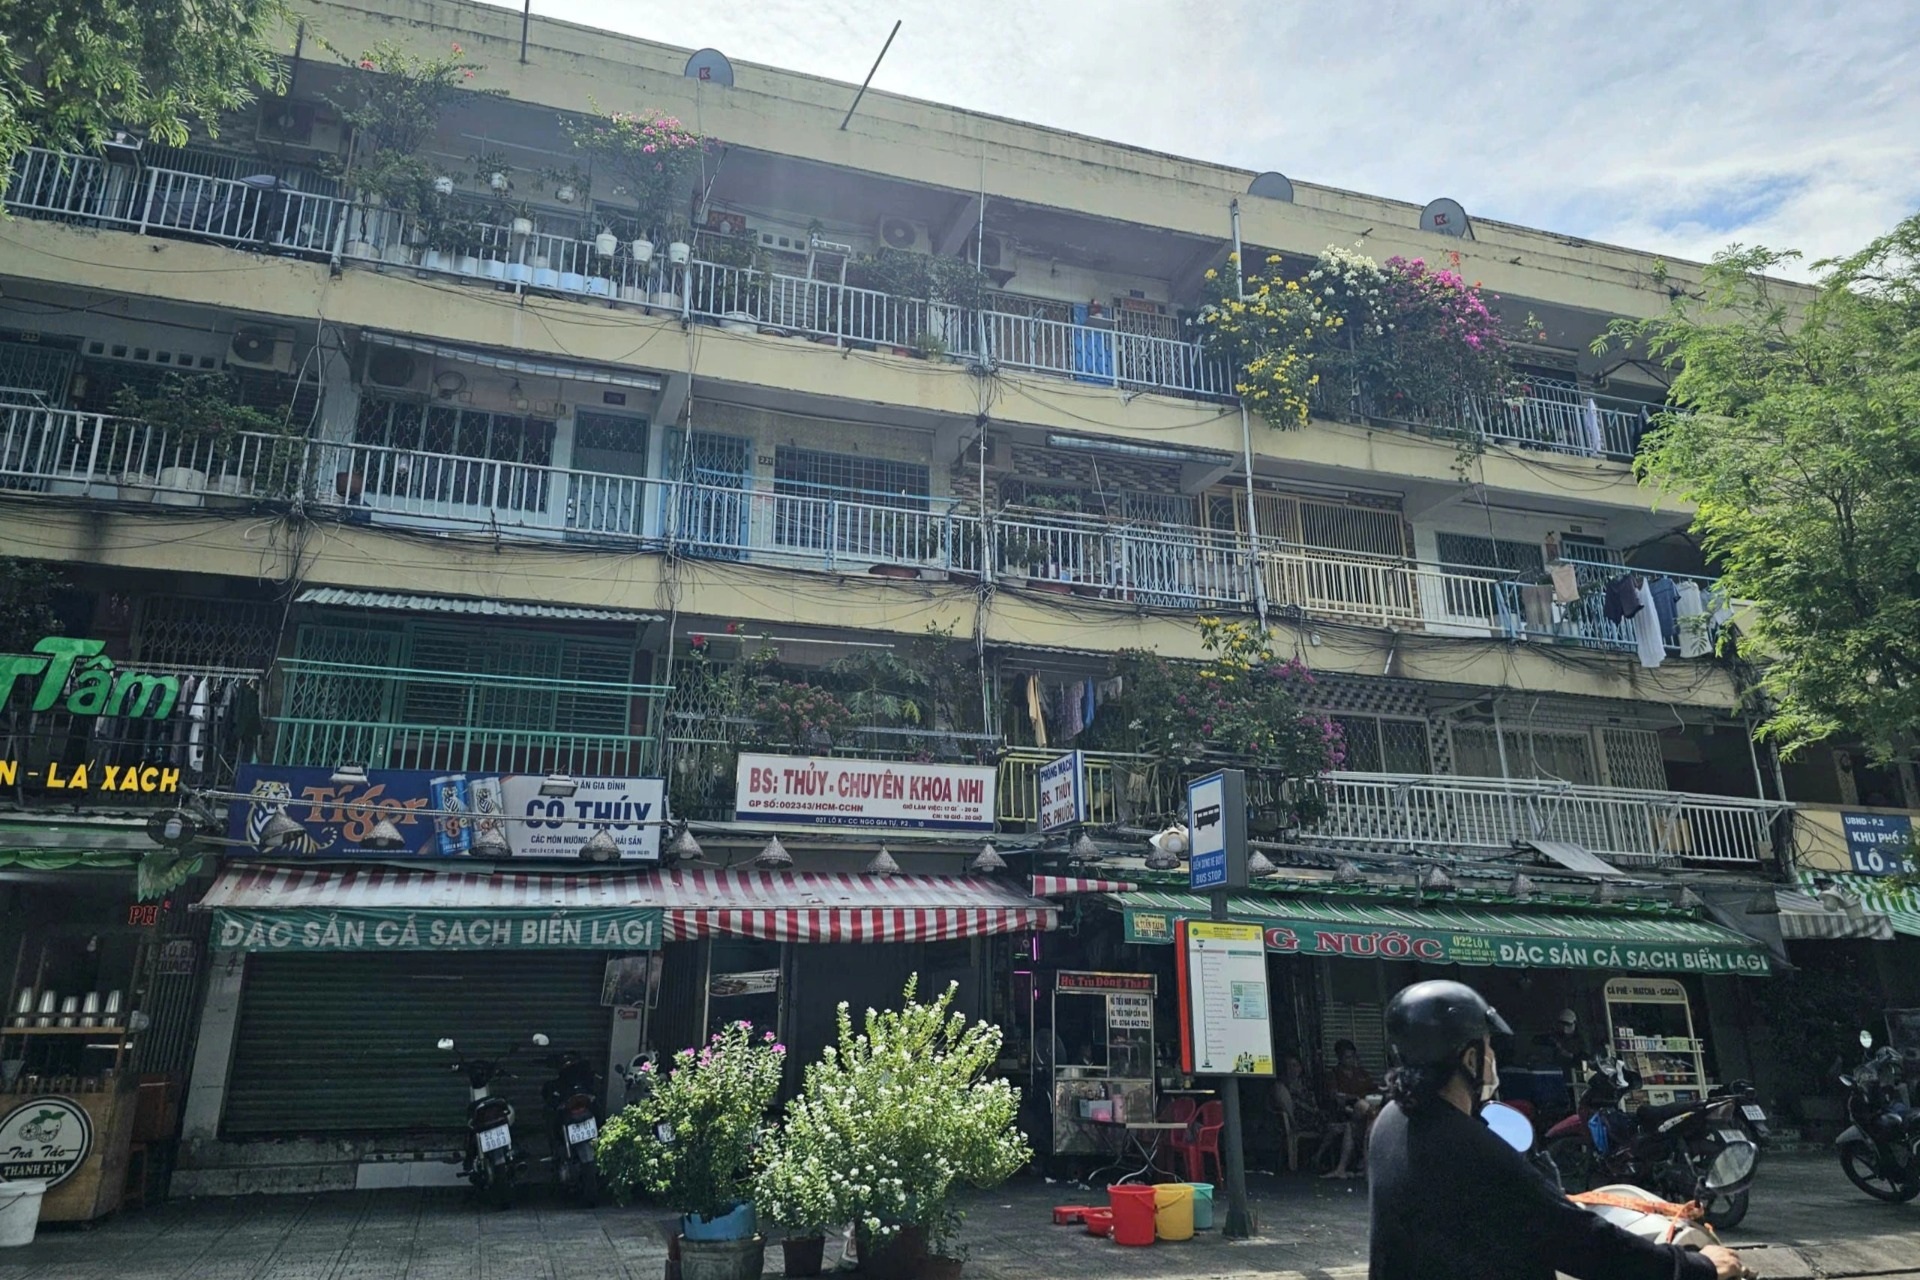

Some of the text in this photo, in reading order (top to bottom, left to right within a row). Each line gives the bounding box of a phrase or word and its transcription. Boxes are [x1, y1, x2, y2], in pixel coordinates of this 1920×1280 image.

[32, 637, 179, 720] Tâm
[47, 759, 95, 789] LÁ
[101, 761, 180, 793] XÁCH
[1057, 758, 1073, 775] MẠCH
[592, 781, 605, 790] GIA
[607, 781, 626, 791] ĐÌNH
[784, 762, 829, 796] THỦY
[838, 769, 904, 800] CHUYÊN
[910, 775, 953, 803] KHOA
[957, 779, 984, 804] NHI
[1055, 776, 1071, 802] THỦY
[574, 795, 652, 831] THÚY
[829, 816, 837, 824] LÔ
[1845, 817, 1867, 826] UBND
[531, 834, 545, 844] CÁC
[1852, 831, 1876, 843] KHU
[1878, 830, 1899, 844] PHỐ
[1855, 848, 1884, 871] LÔ
[1196, 869, 1222, 884] BUS STOP
[221, 914, 293, 952] ĐẶC
[302, 913, 365, 947] SẢN
[429, 918, 512, 950] SẠCH
[521, 909, 582, 945] BIỂN
[590, 919, 653, 946] LAGI
[1314, 931, 1444, 959] NƯỚC
[1473, 936, 1483, 948] LÔ
[1500, 941, 1769, 971] ĐẶC SẢN CÁ SẠCH BIỂN LAGI
[4, 1161, 66, 1176] THANH TÂM
